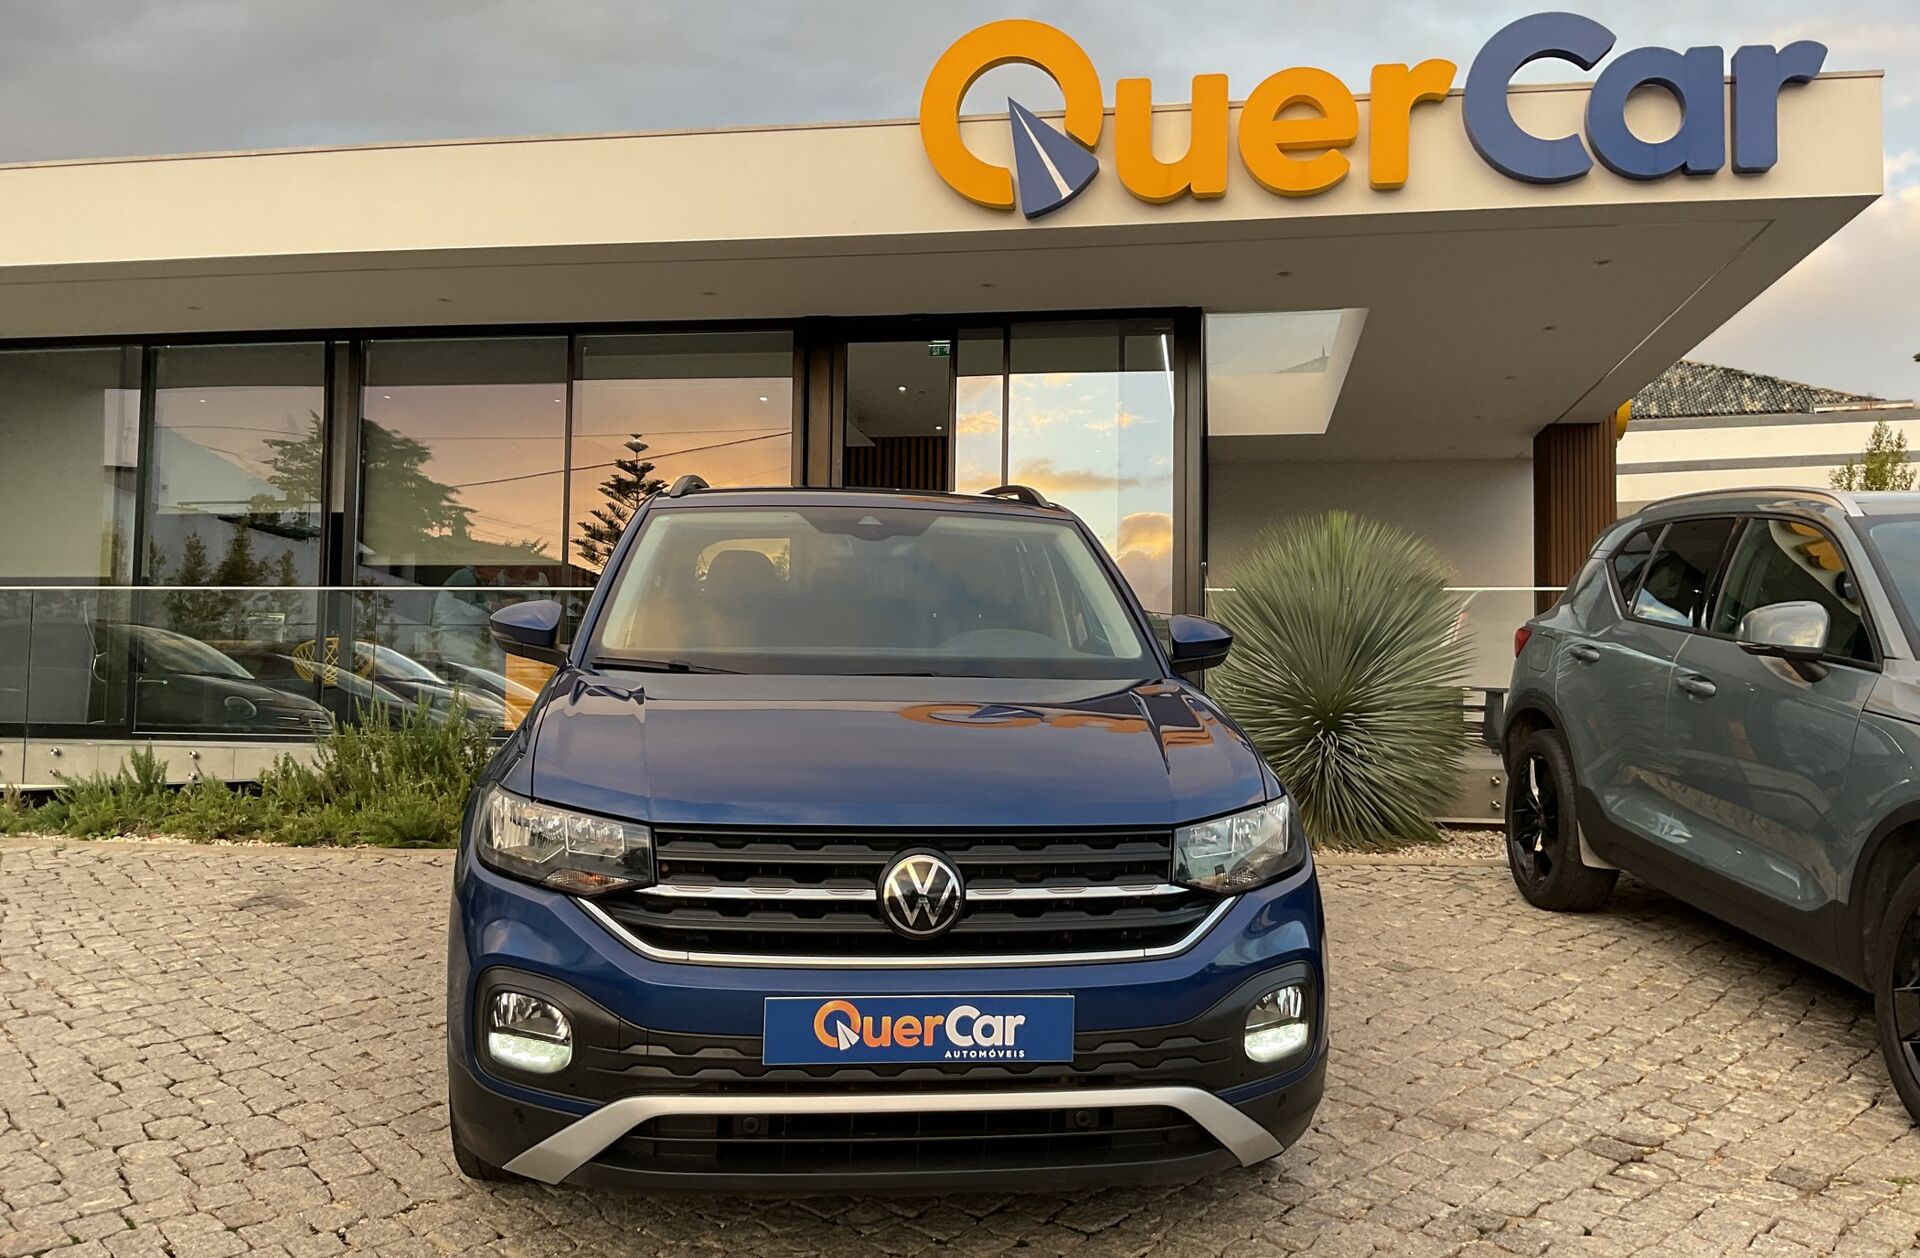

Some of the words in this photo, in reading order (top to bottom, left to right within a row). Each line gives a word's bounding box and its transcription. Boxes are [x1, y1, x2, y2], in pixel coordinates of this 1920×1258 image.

[920, 12, 1828, 220] QuerCar
[885, 856, 959, 931] VW
[813, 1000, 1026, 1050] QuerCar
[944, 1049, 1025, 1058] AUTOMÓVEIS
